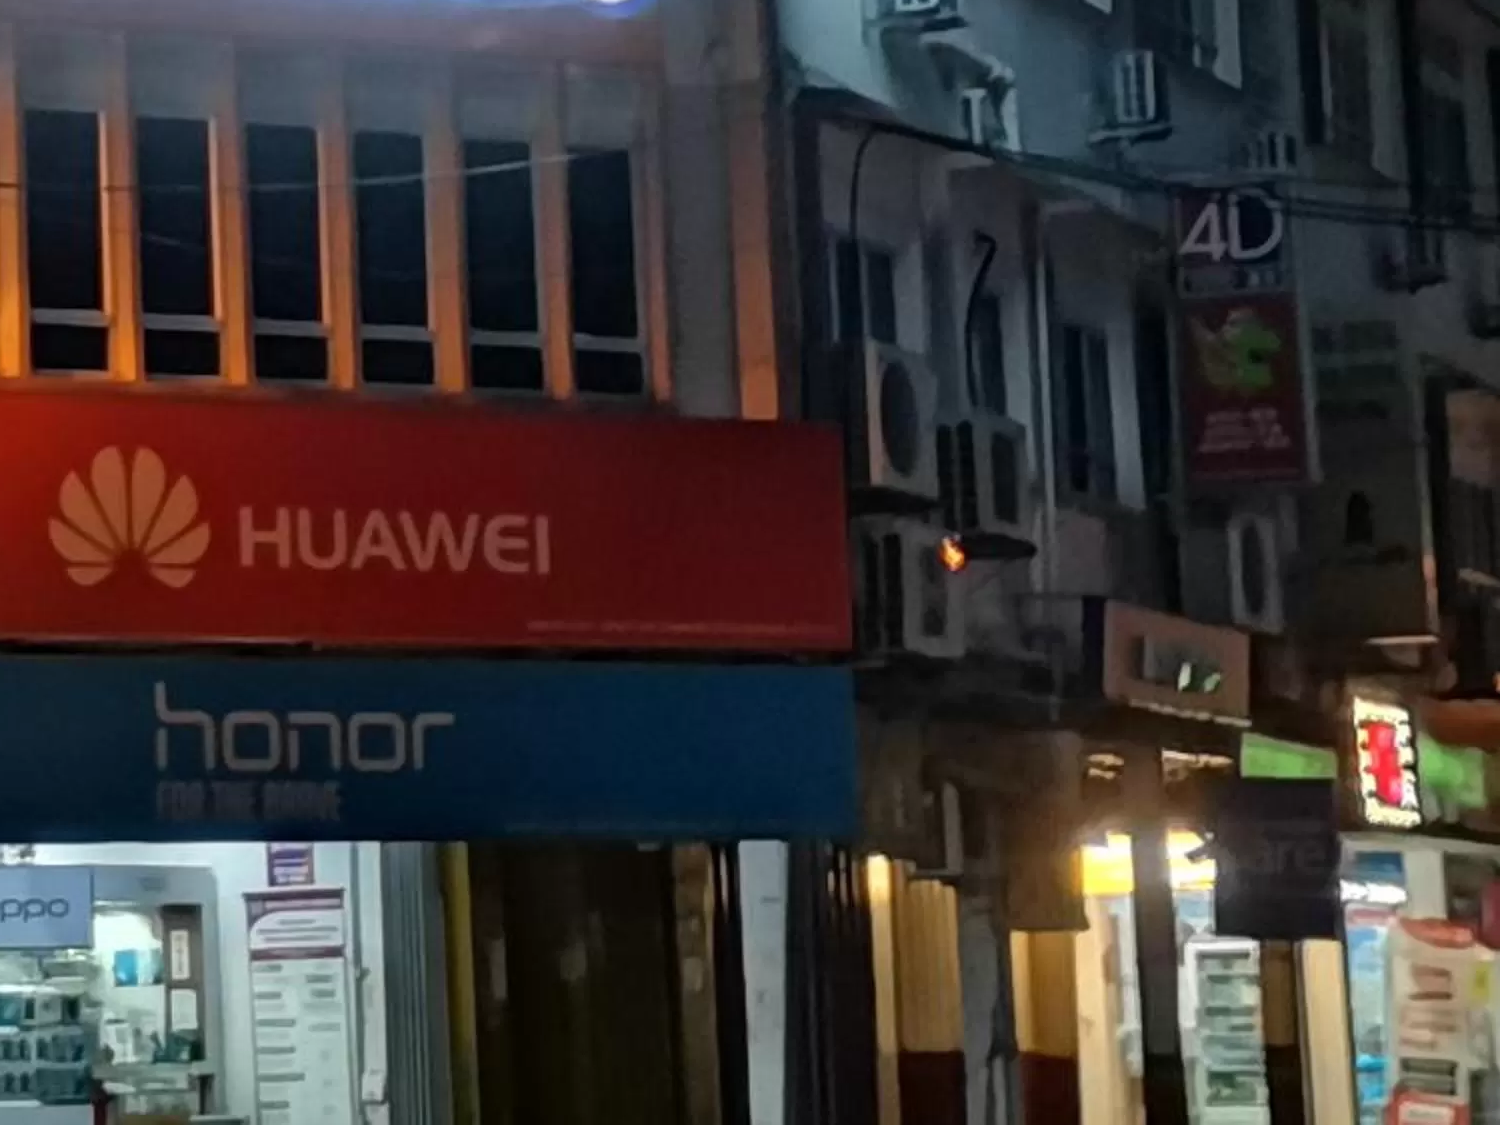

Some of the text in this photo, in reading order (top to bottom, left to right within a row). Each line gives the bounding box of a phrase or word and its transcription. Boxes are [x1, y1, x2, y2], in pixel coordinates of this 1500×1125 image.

[1179, 187, 1283, 262] 4D
[238, 506, 551, 575] HUAWEI
[154, 680, 456, 772] honor
